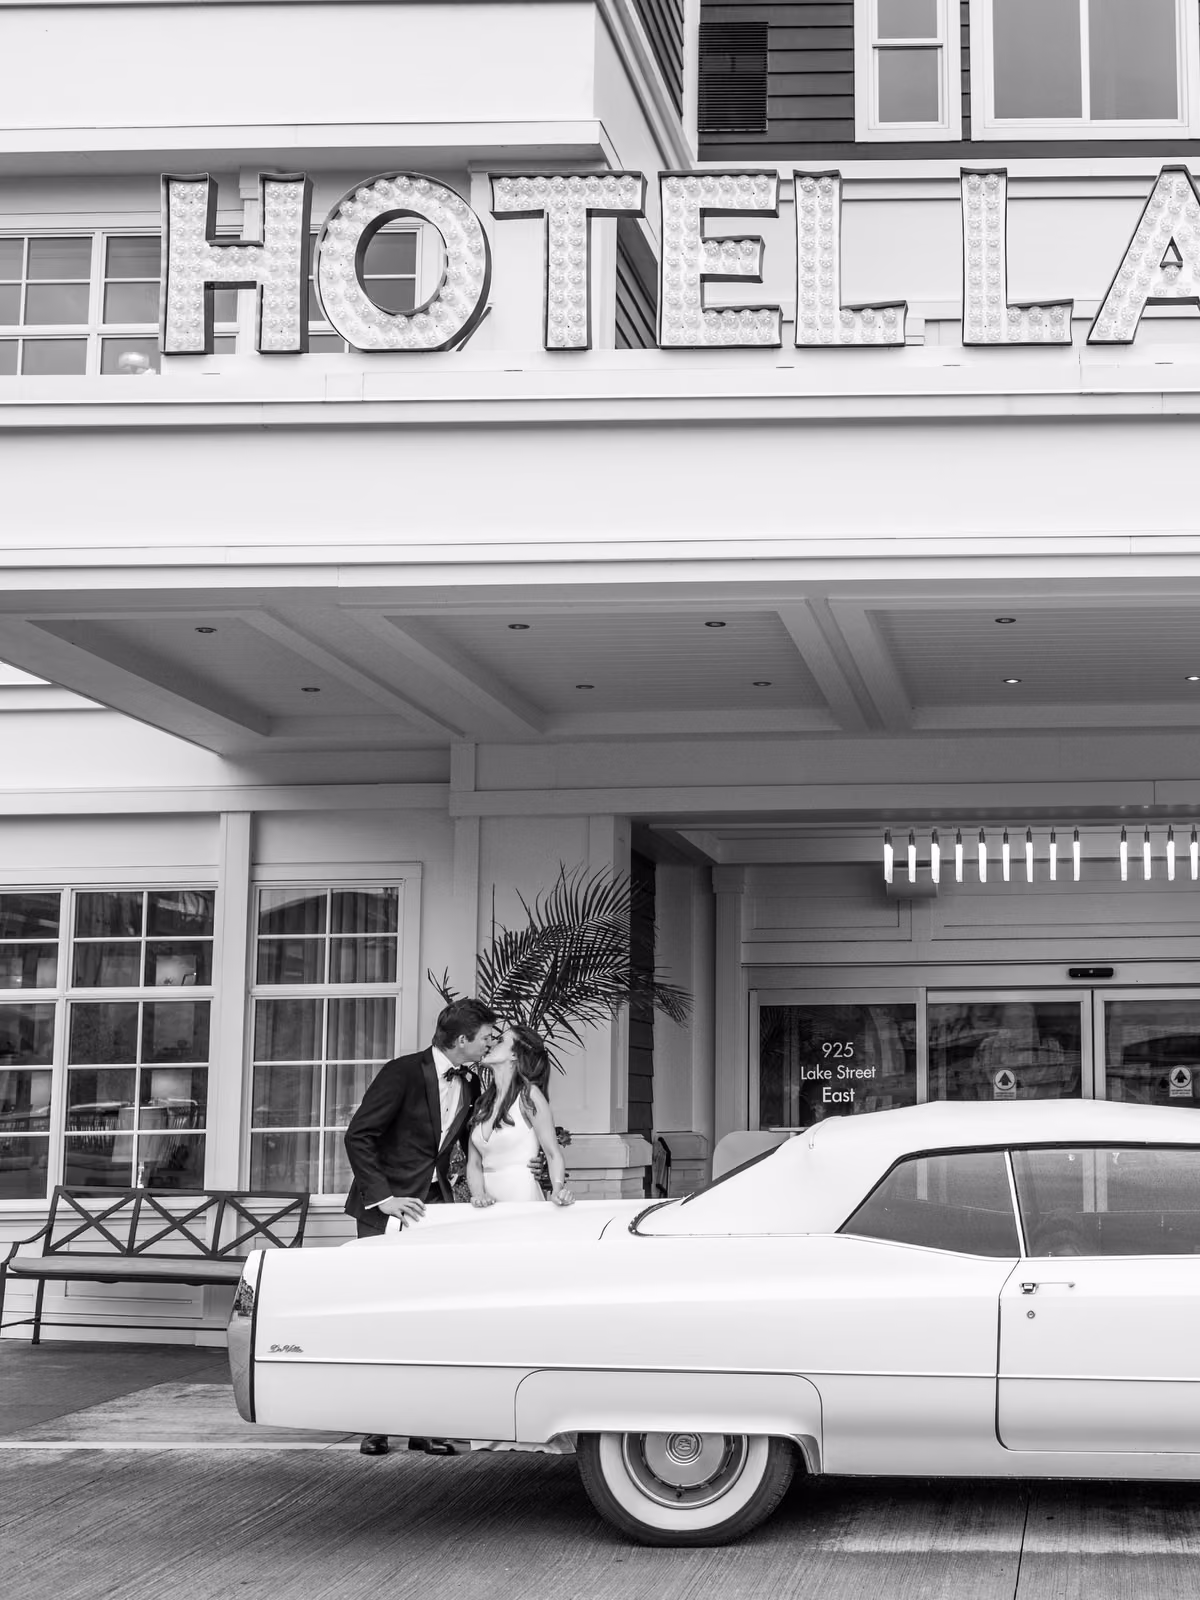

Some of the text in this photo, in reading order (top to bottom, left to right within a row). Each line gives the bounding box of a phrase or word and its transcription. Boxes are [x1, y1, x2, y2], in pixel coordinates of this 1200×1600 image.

[160, 168, 908, 354] HOTEL
[822, 1042, 854, 1058] 925
[801, 1064, 876, 1080] Lake Street
[823, 1087, 855, 1103] East
